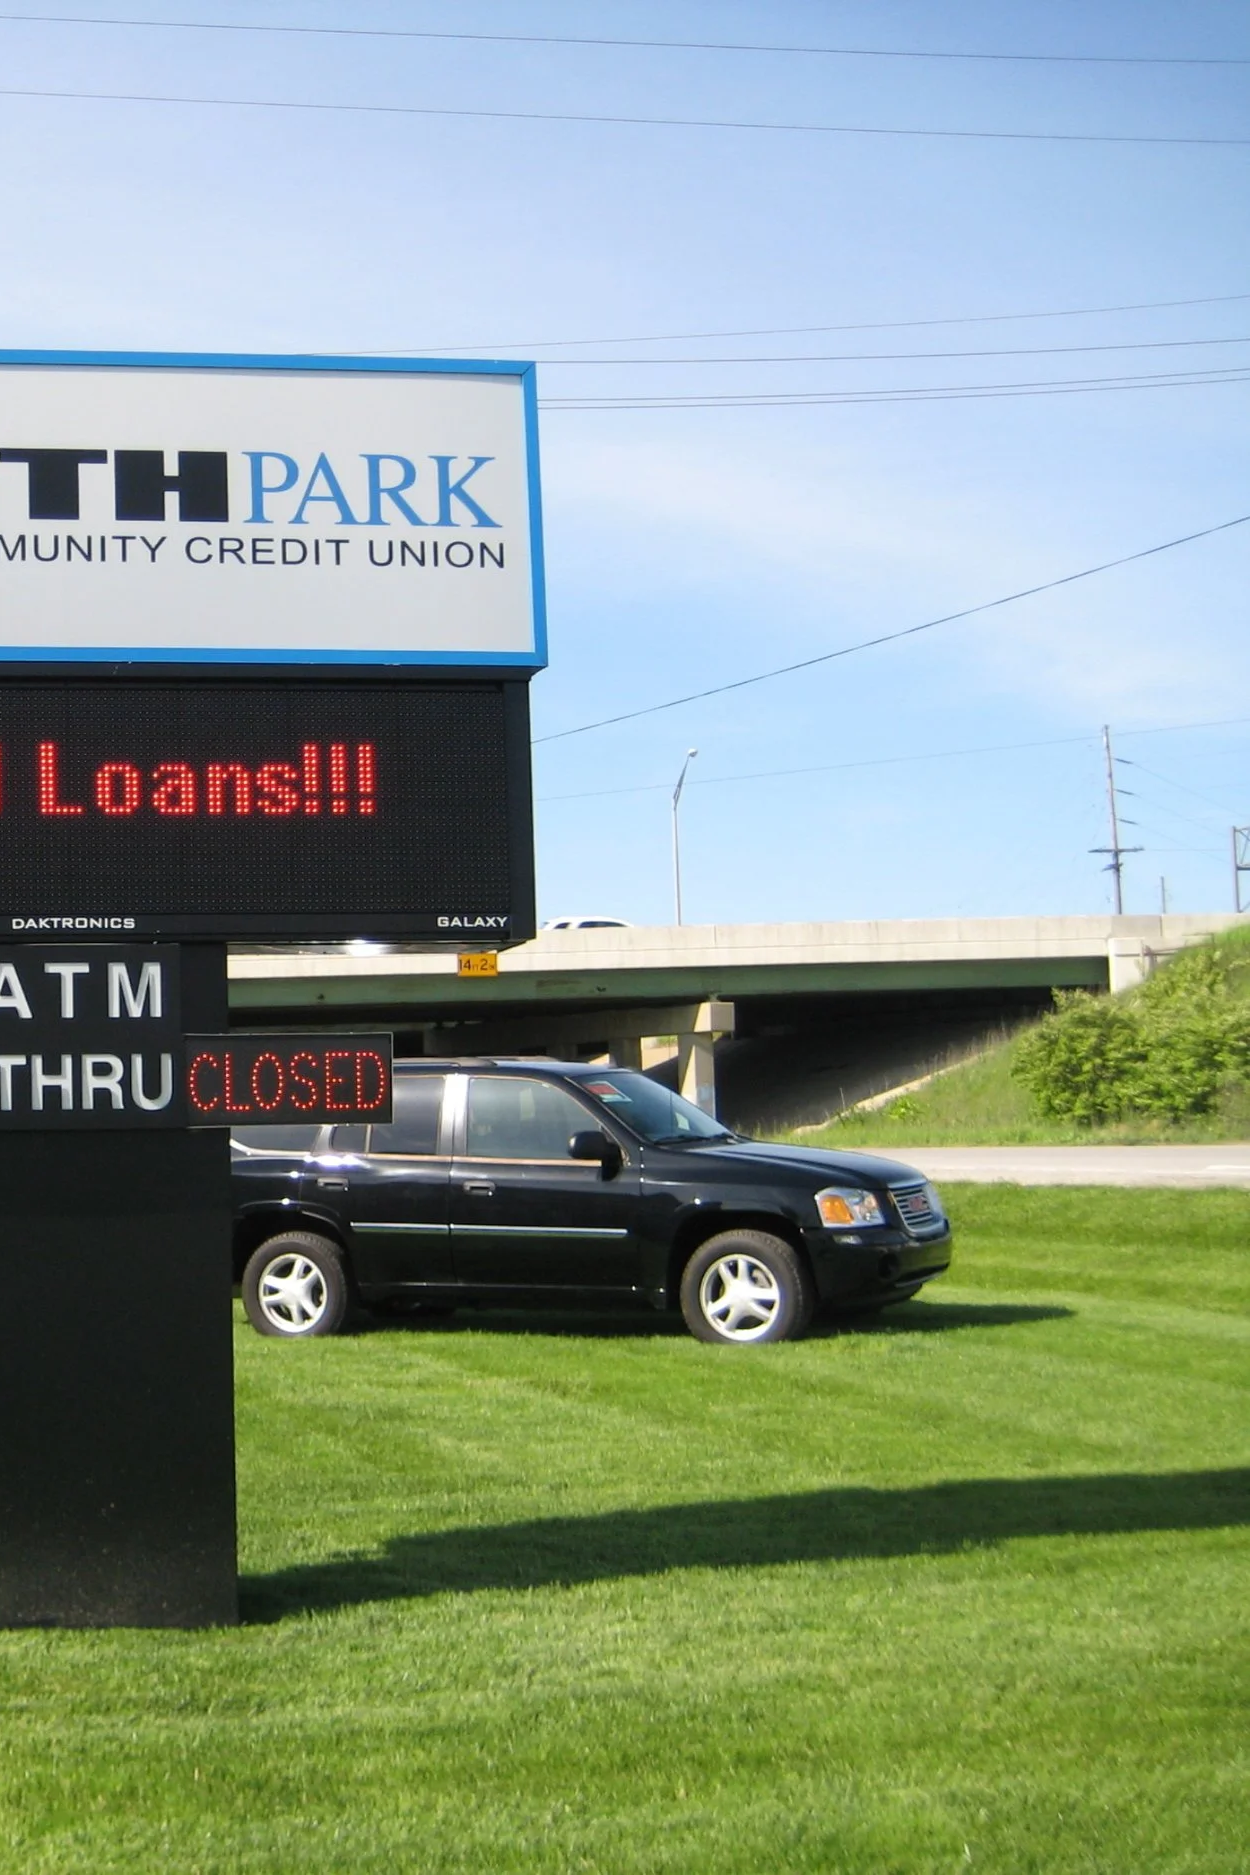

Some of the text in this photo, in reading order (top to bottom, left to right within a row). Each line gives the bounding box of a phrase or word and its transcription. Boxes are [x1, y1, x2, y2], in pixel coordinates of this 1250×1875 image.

[184, 536, 350, 566] CREDIT
[368, 539, 505, 569] UNION
[38, 741, 375, 816] Loans!!!
[11, 917, 136, 930] DAKTRONICS
[436, 916, 508, 928] GALAXY
[188, 1052, 386, 1112] CLOSED
